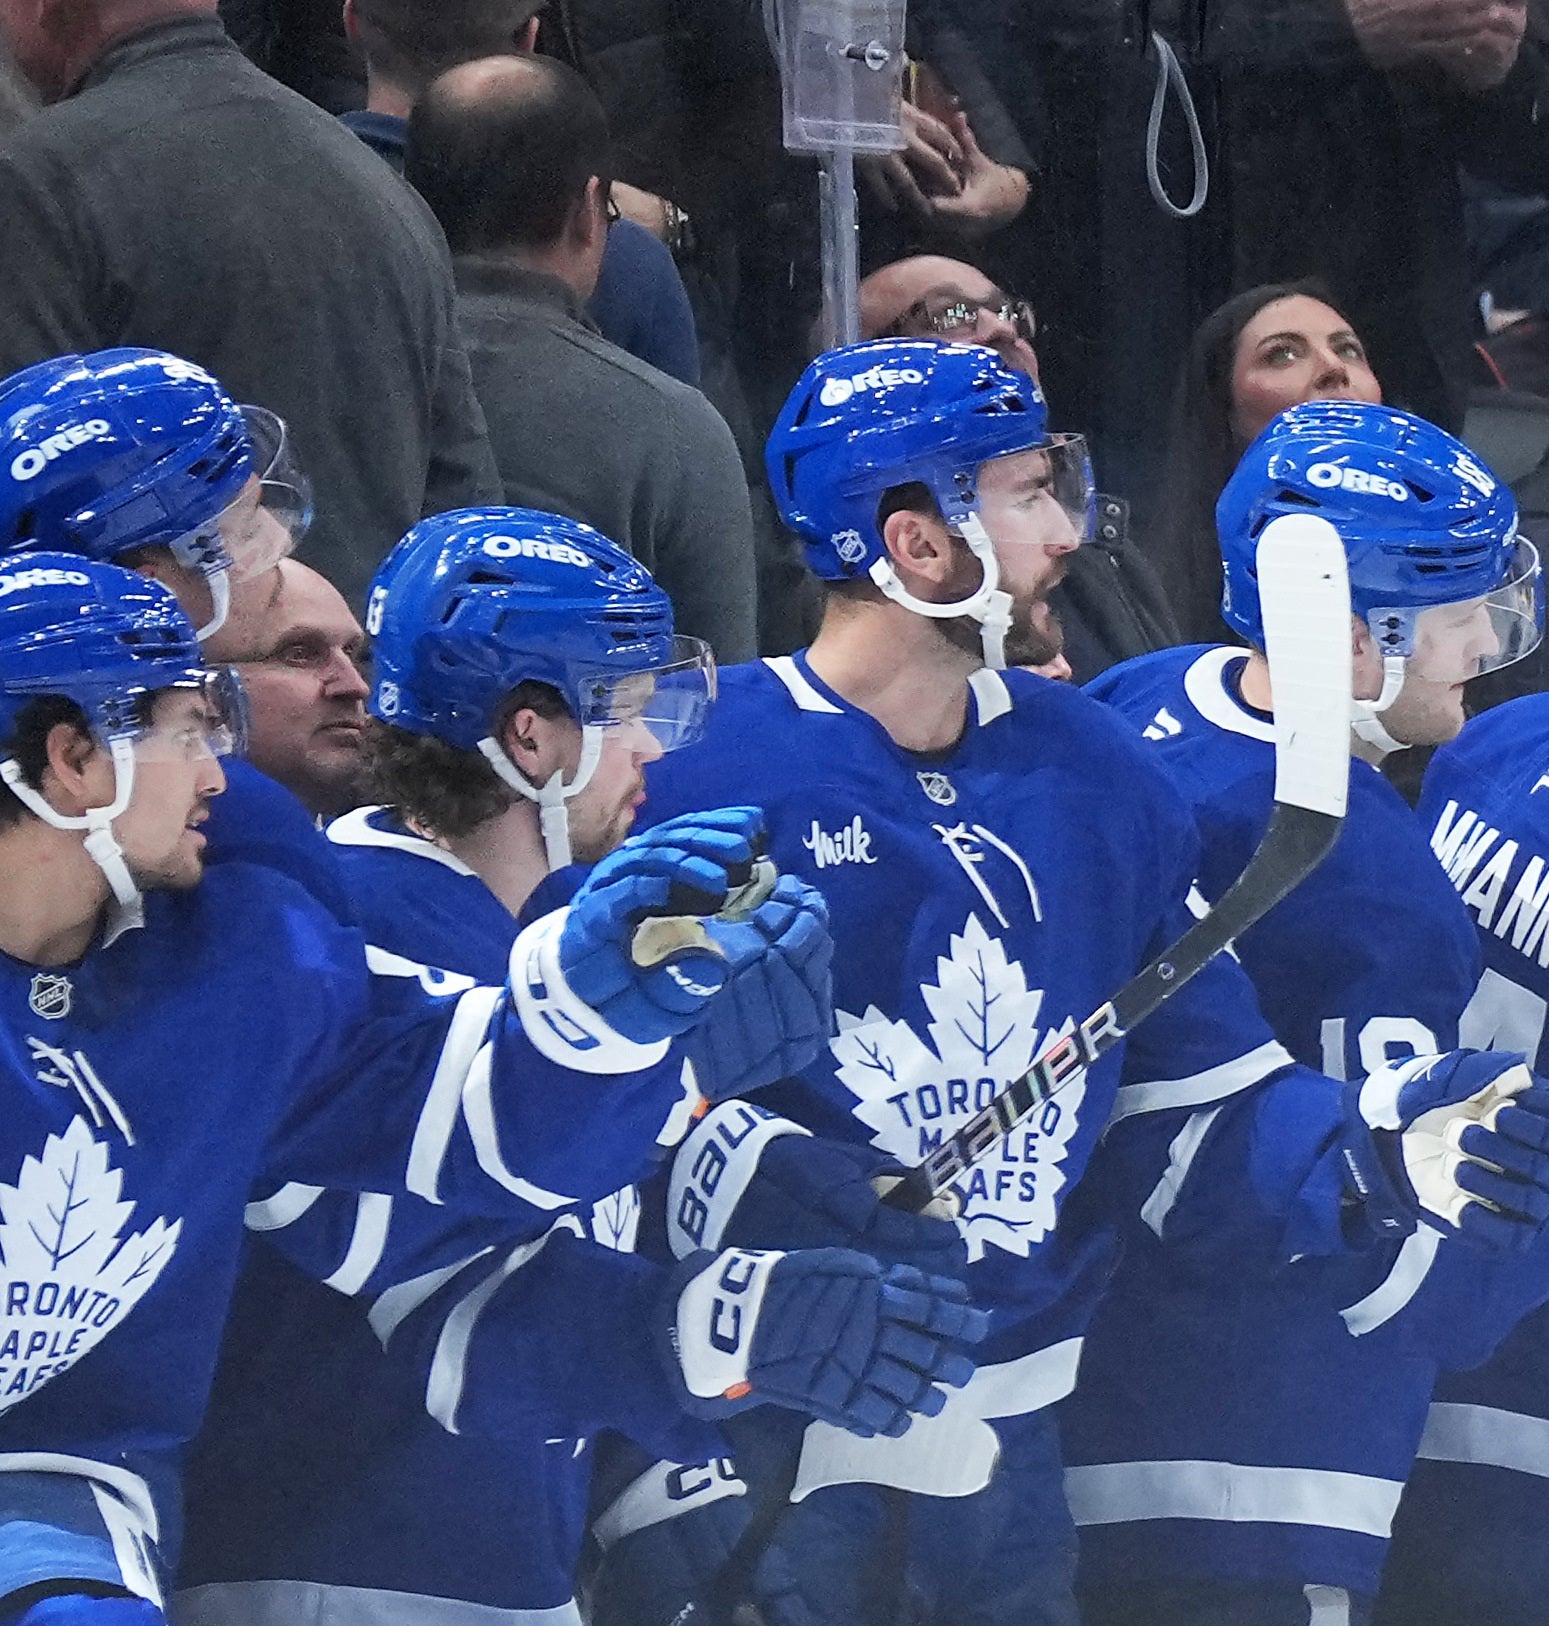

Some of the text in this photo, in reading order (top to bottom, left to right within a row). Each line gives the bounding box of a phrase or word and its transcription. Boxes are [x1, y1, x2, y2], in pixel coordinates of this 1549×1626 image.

[819, 367, 923, 407] OREO
[10, 417, 110, 482] OREO
[1306, 462, 1409, 502] OREO
[483, 535, 592, 568] OREO
[802, 814, 878, 869] Milk
[919, 1126, 1040, 1164] MLE
[965, 1168, 1038, 1203] AFS
[6, 1281, 121, 1329] RONTO
[709, 1250, 766, 1355] CC
[0, 1328, 88, 1360] APLE
[0, 1360, 69, 1396] AFS
